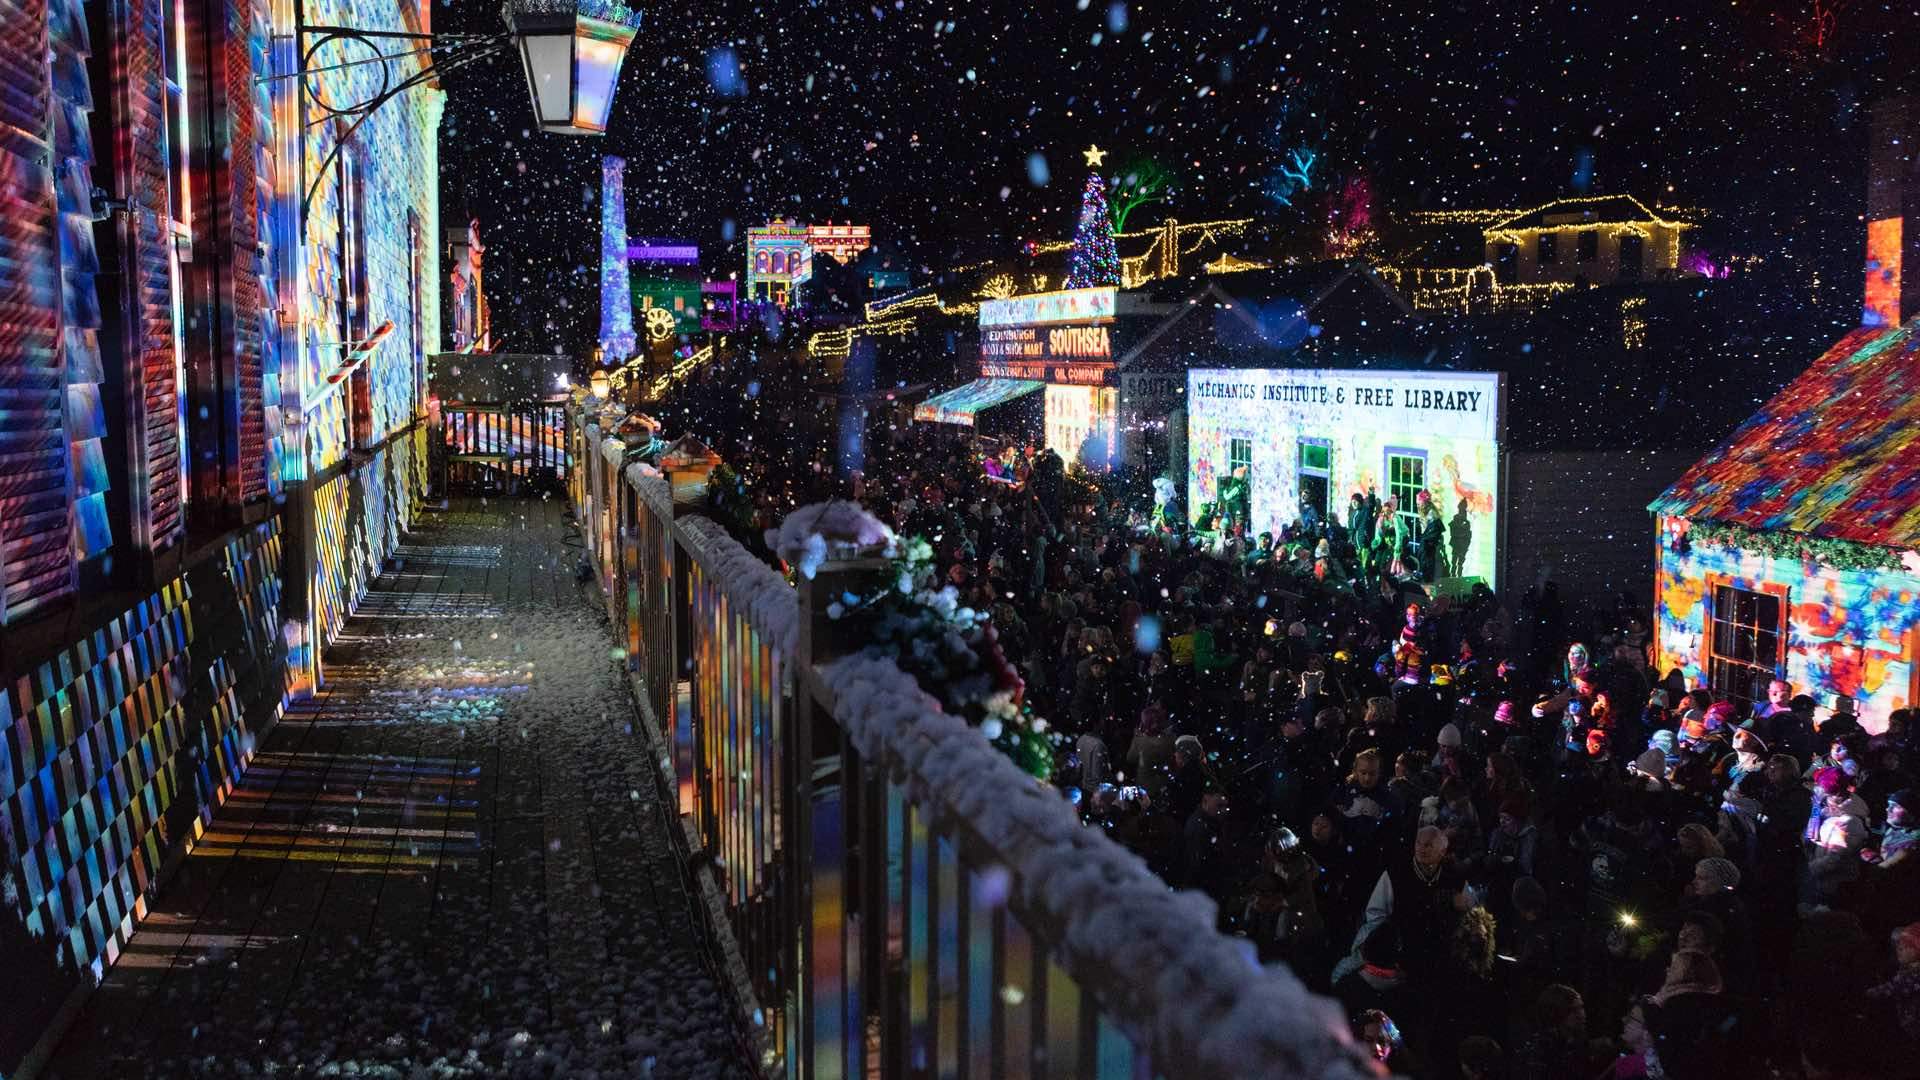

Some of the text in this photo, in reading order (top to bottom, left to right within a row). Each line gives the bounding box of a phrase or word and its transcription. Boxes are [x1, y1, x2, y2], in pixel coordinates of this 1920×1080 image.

[1024, 342, 1043, 355] MART
[1050, 327, 1110, 356] SOUTHSEA
[1055, 367, 1104, 381] OIL COMPANY
[1196, 382, 1481, 411] MECHANICS INSTITUTE & FREE LIBRARY
